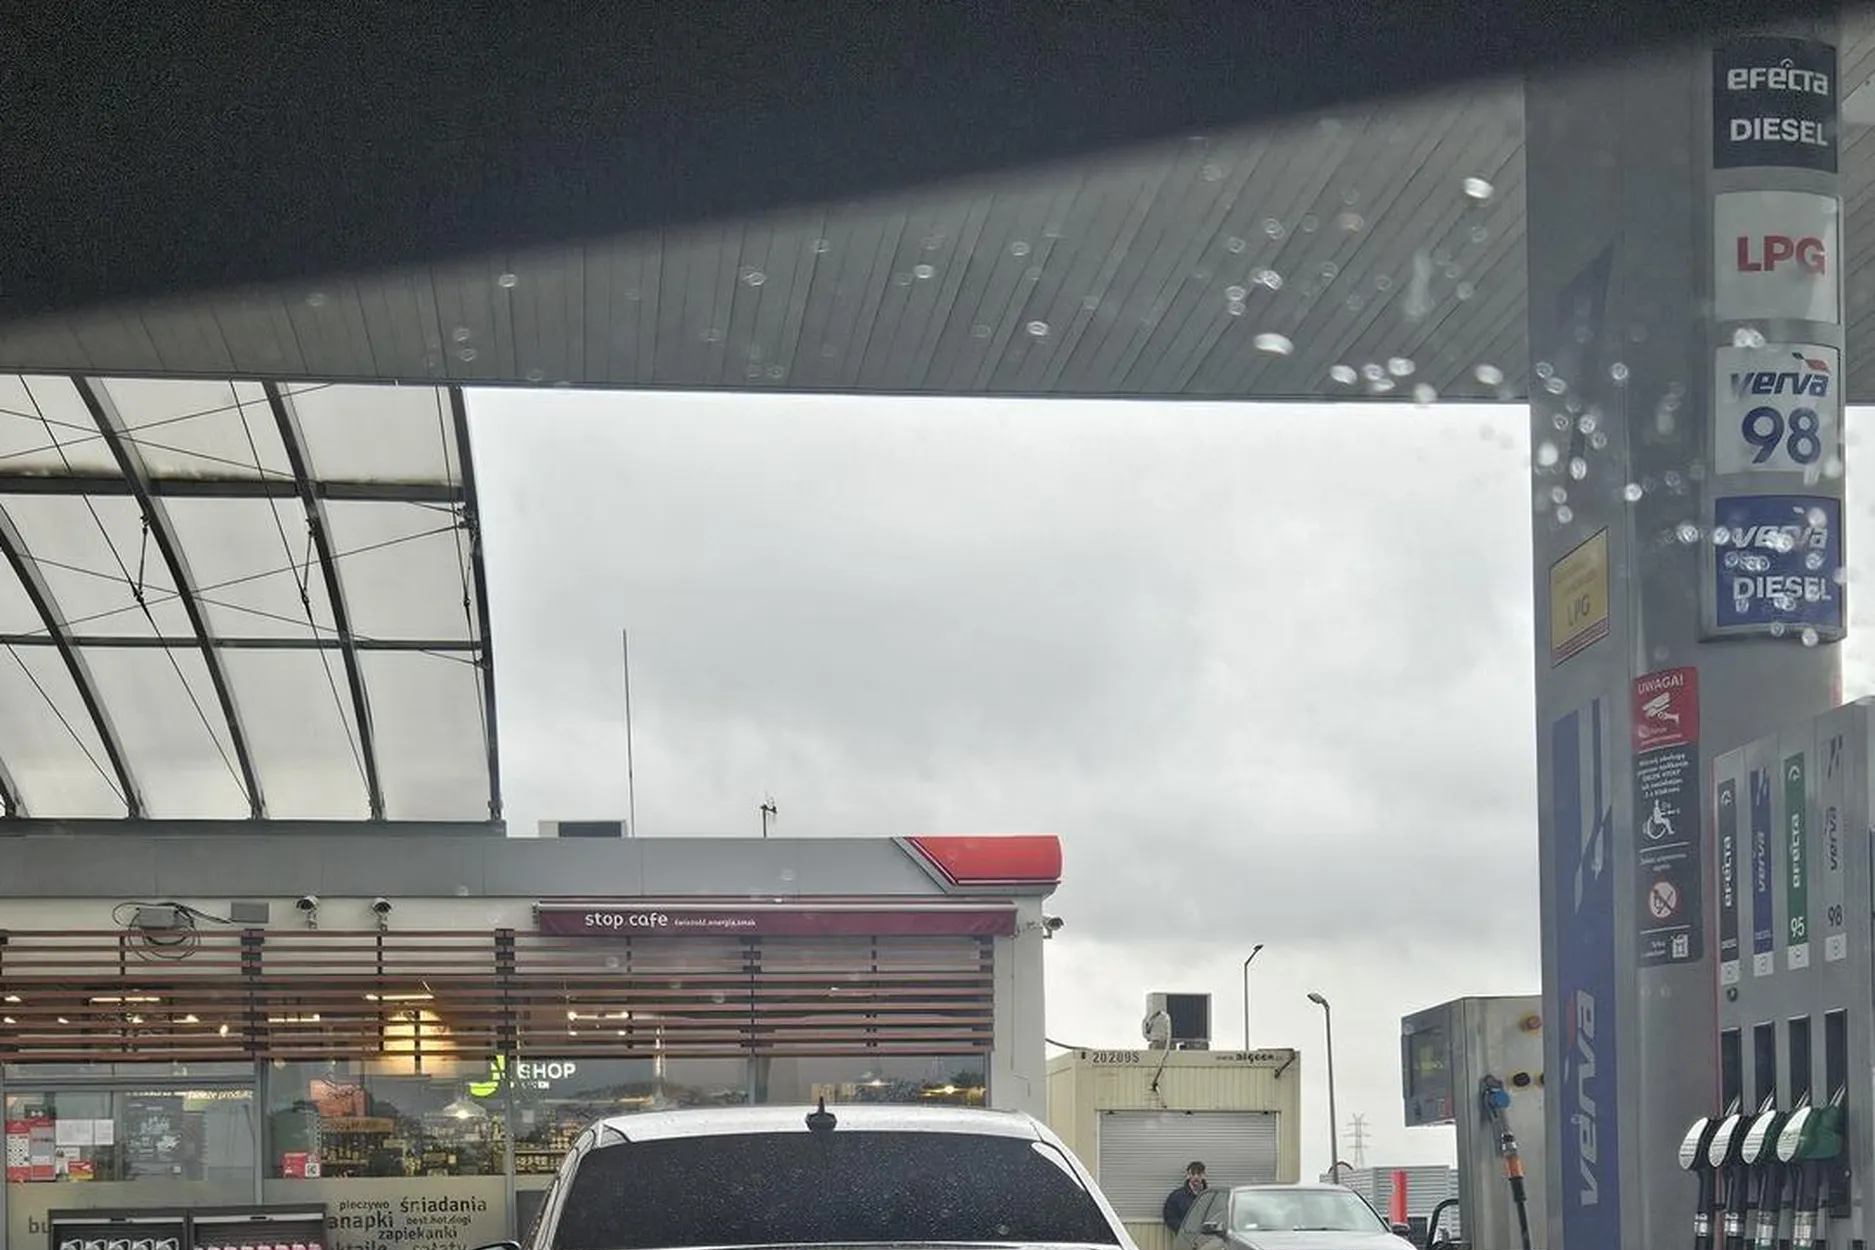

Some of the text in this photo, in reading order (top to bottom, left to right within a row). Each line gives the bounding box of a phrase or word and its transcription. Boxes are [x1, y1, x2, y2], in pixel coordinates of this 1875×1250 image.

[1726, 62, 1829, 96] efecta
[1729, 117, 1829, 147] DIESEL
[1736, 234, 1827, 277] LPG
[1729, 368, 1829, 399] verva
[1740, 405, 1822, 466] 98
[1732, 575, 1833, 601] DIESEL
[1637, 672, 1685, 695] UWAGA!
[584, 912, 625, 930] stop
[628, 912, 669, 928] cafe
[1790, 915, 1806, 938] 95
[1827, 903, 1843, 927] 98
[518, 1062, 576, 1080] SHOP
[1576, 989, 1599, 1207] verva
[339, 1200, 390, 1212] pieczywo
[400, 1195, 487, 1213] śniadania
[327, 1211, 394, 1232] anapki
[378, 1225, 458, 1243] zapiekanki
